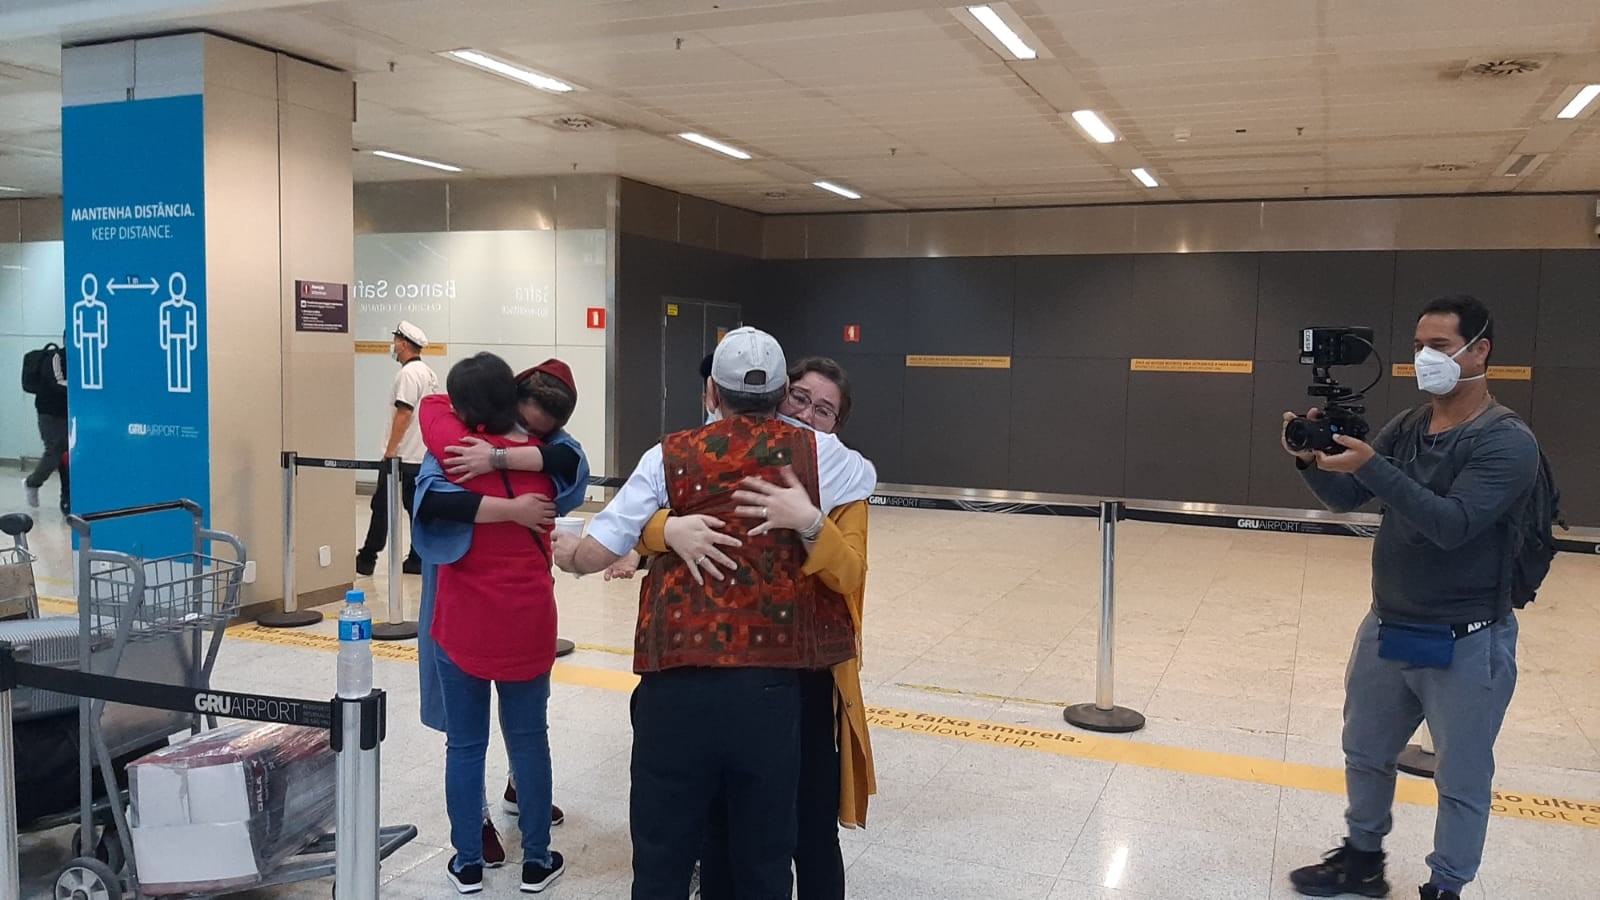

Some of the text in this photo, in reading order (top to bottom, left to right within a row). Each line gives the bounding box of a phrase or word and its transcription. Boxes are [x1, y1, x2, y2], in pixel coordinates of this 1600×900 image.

[71, 201, 195, 221] MANTENHA DISTÂNCIA.
[91, 224, 173, 240] KEEP DISTANCE.
[866, 716, 1040, 749] he yellow strip.
[914, 713, 971, 728] faixa
[977, 722, 1082, 744] amarela.
[251, 759, 264, 812] GALAY
[1518, 807, 1572, 822] not
